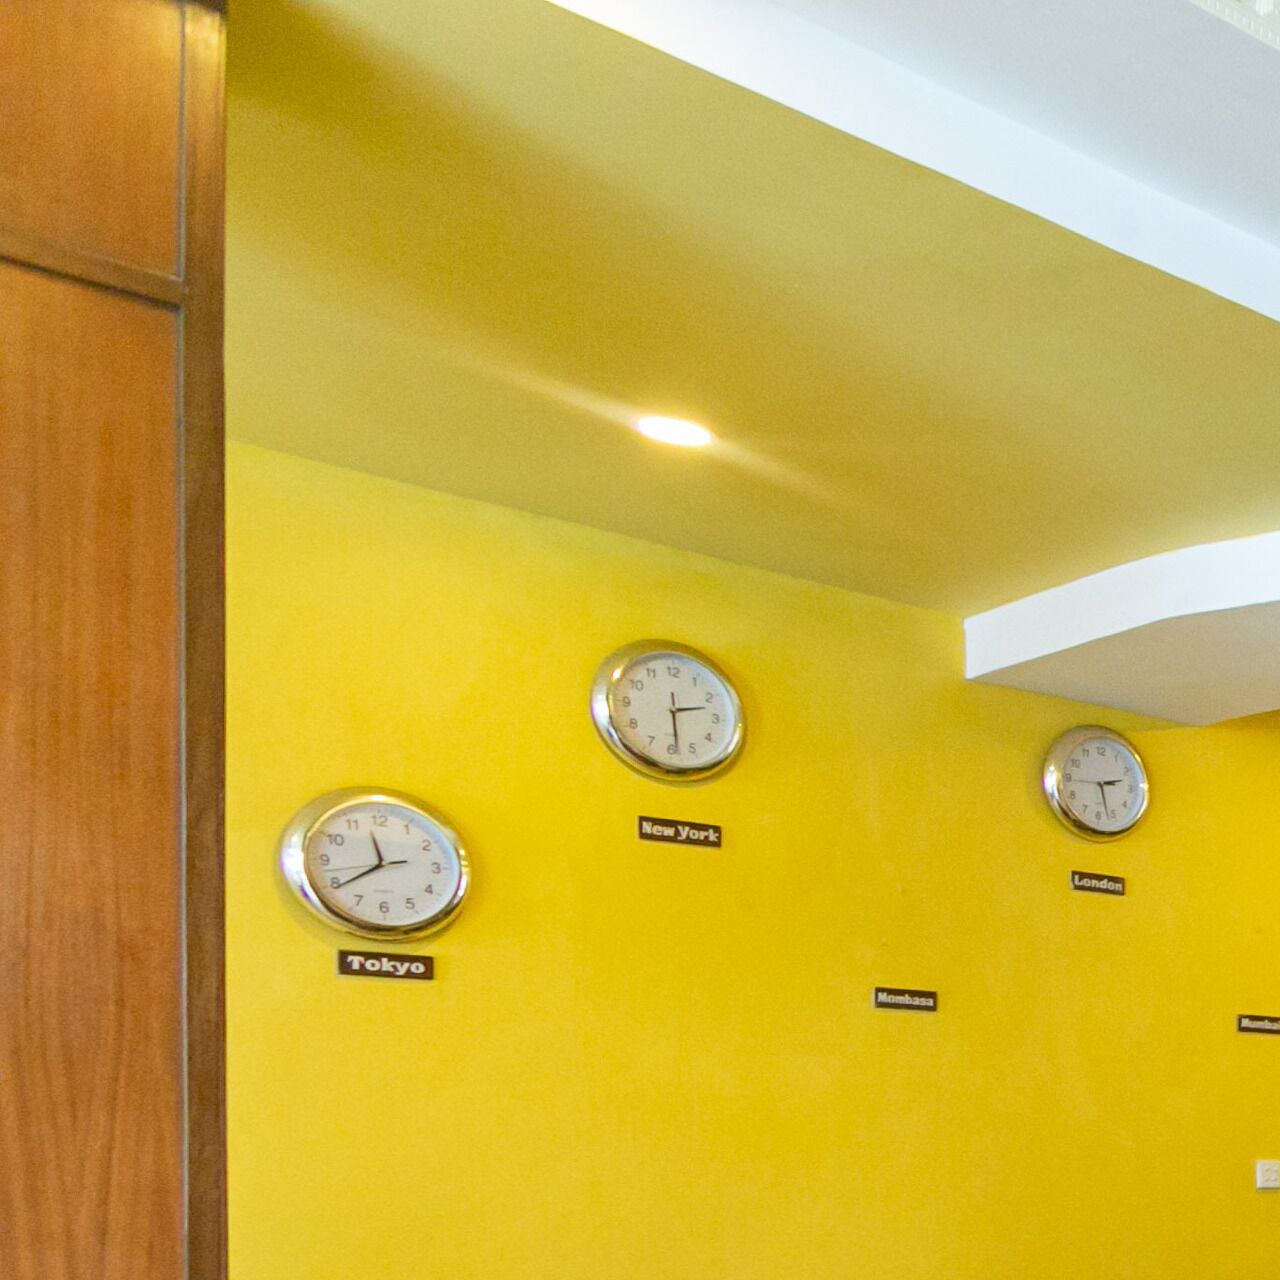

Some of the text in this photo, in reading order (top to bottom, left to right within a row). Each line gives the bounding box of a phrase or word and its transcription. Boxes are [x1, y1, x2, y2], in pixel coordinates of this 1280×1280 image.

[646, 668, 656, 678] 11
[667, 666, 680, 678] 12
[631, 680, 644, 691] 10
[692, 677, 697, 686] 1
[623, 696, 631, 707] 9
[705, 693, 713, 703] 2
[629, 718, 638, 729] 8
[712, 714, 720, 724] 3
[648, 736, 656, 746] 7
[705, 733, 713, 742] 4
[667, 744, 677, 755] 6
[689, 743, 697, 754] 5
[346, 820, 359, 831] 11
[371, 815, 388, 828] 12
[404, 824, 410, 835] 1
[641, 821, 719, 841] New York
[327, 833, 345, 847] 10
[422, 840, 432, 852] 2
[319, 853, 330, 867] 9
[431, 862, 441, 874] 3
[330, 876, 341, 889] 8
[1074, 875, 1123, 891] London
[424, 884, 434, 895] 4
[354, 894, 364, 907] 7
[405, 898, 416, 910] 5
[379, 901, 390, 914] 6
[346, 955, 426, 975] Tokyo
[877, 992, 934, 1006] Mombasa
